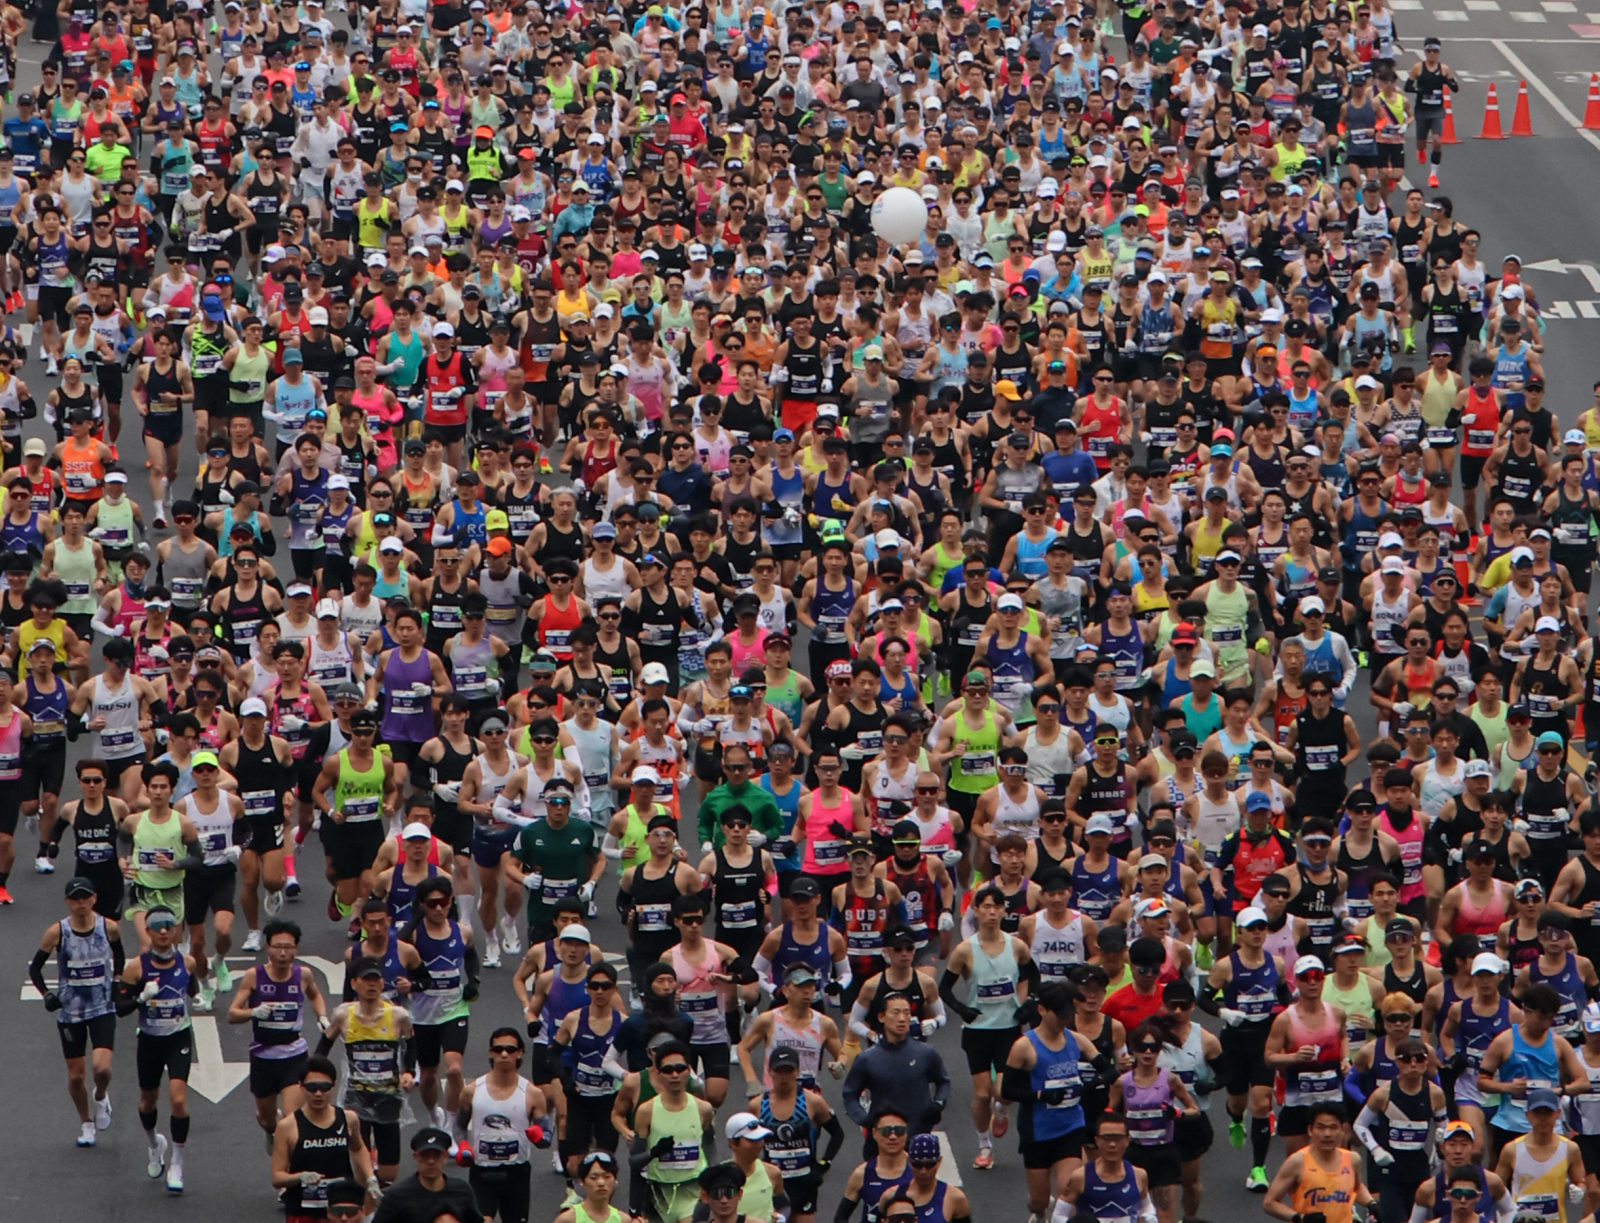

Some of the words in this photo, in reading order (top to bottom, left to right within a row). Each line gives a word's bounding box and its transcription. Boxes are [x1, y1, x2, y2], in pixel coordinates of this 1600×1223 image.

[65, 461, 93, 471] SSRT
[1375, 612, 1403, 620] KOREA
[1043, 941, 1075, 952] 74RC
[303, 1138, 347, 1149] DALISHA
